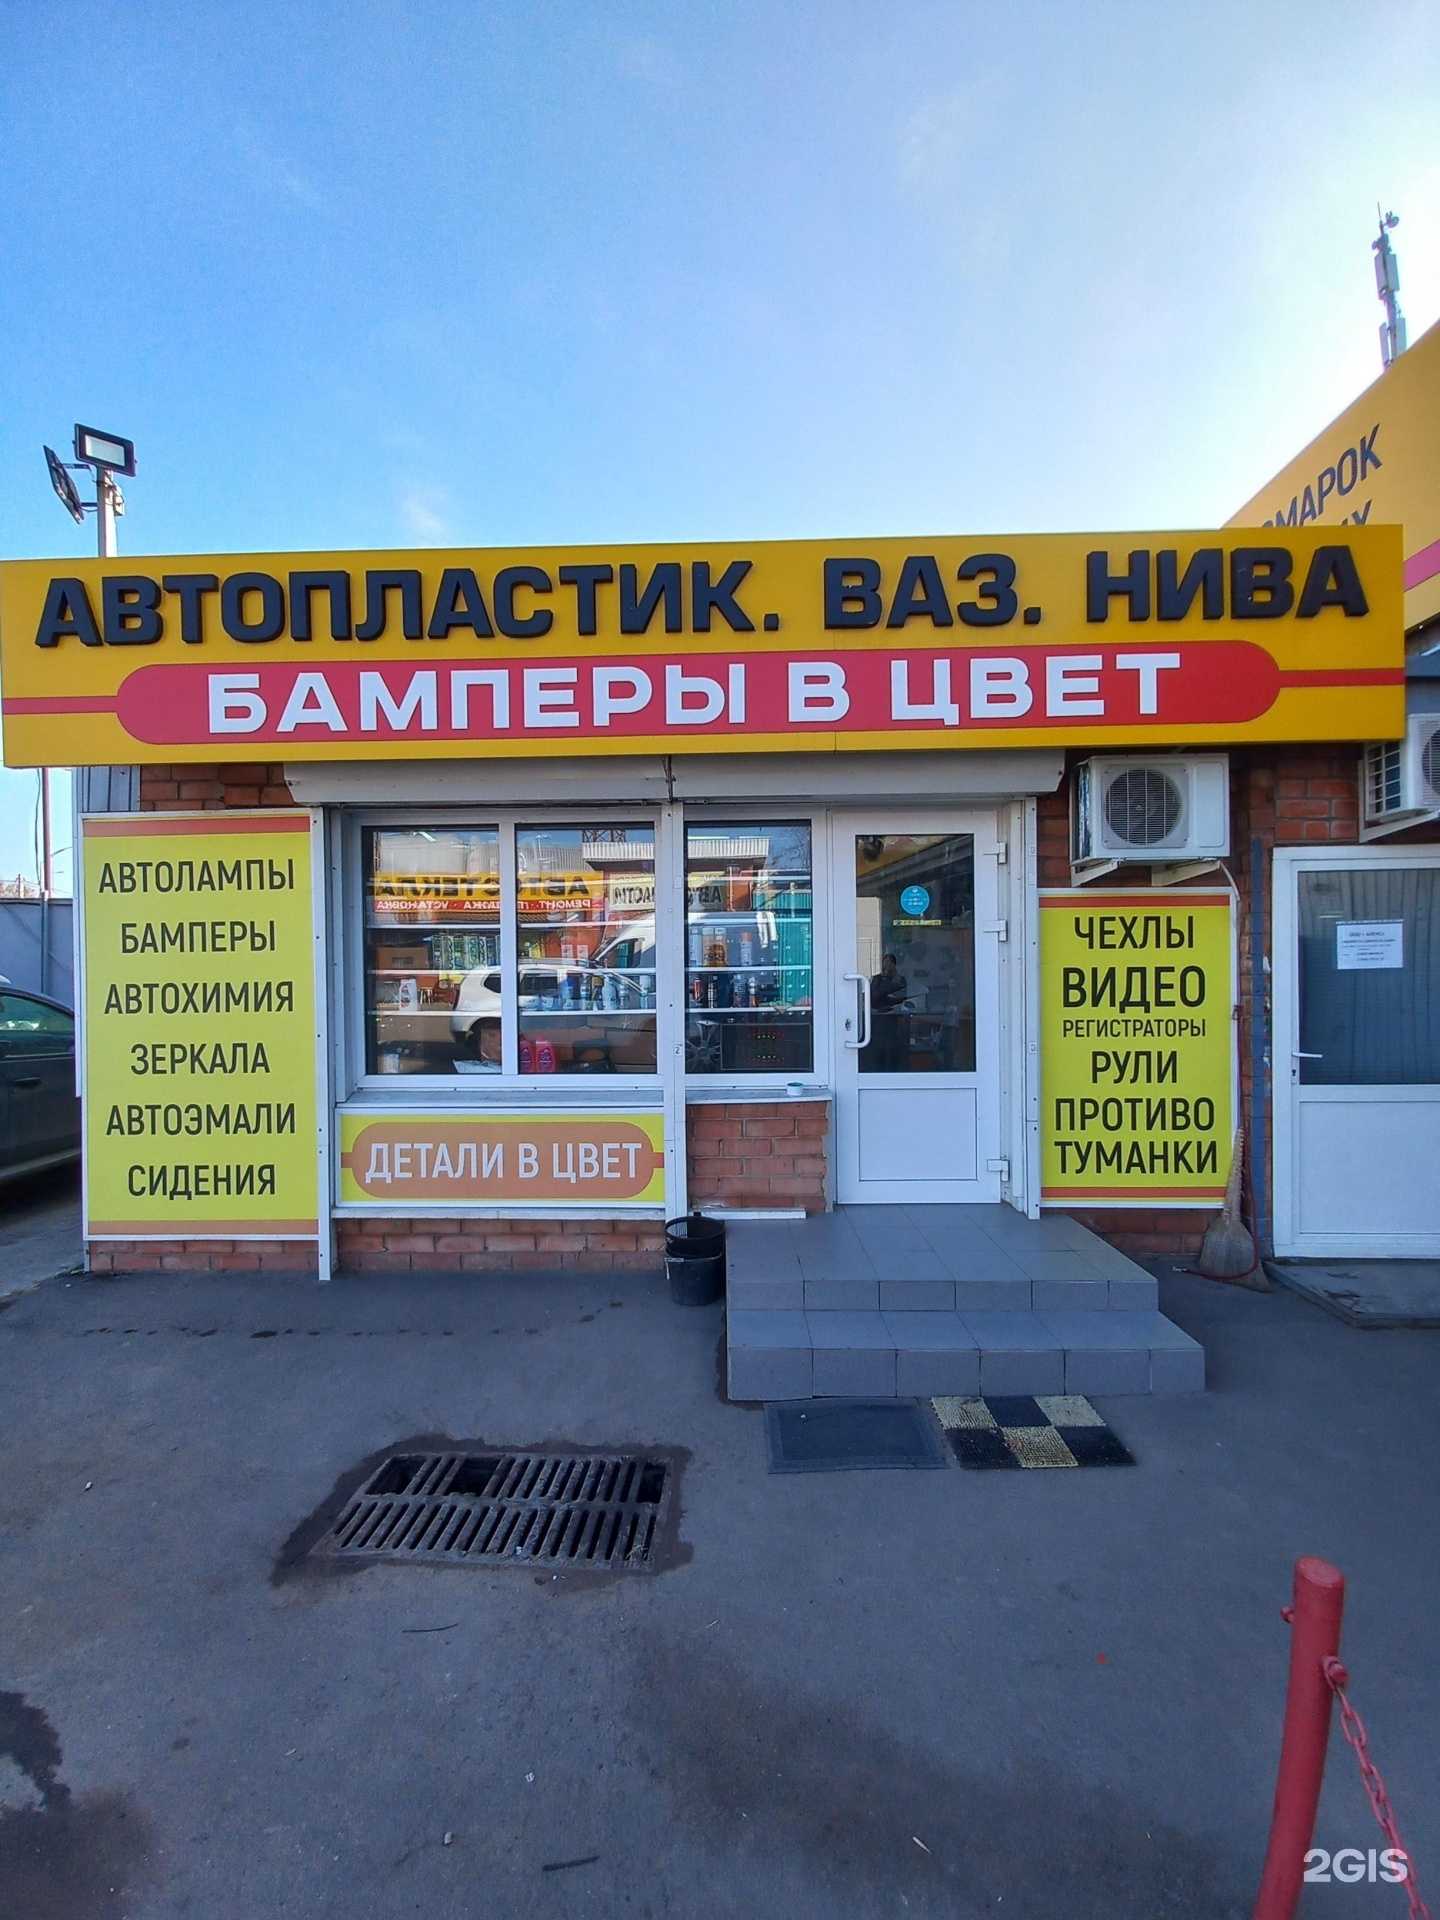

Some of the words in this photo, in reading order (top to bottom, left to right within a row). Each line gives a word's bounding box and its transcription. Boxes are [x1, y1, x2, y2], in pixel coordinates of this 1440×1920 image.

[36, 560, 779, 647] АВТОПЛАСТИК.
[823, 553, 1042, 629] ВАЗ.
[1085, 545, 1370, 622] НИВА
[207, 662, 746, 734] БАМПЕРЫ
[787, 661, 850, 723] В
[890, 652, 1181, 726] ЦВЕТ
[99, 859, 294, 893] АВТОЛАМПЫ
[121, 920, 276, 954] БАМПЕРЫ
[1074, 916, 1194, 949] ЧЕХЛЫ
[104, 981, 294, 1015] АВТОХИМИЯ
[1062, 965, 1206, 1014] ВИДЕО
[1063, 1019, 1206, 1038] РЕГИСТРАТОРЫ
[130, 1042, 270, 1075] ЗЕРКАЛА
[1092, 1051, 1177, 1084] РУЛИ
[106, 1103, 295, 1136] АВТОЭМАЛИ
[1056, 1097, 1215, 1131] ПРОТИВО
[365, 1143, 503, 1184] ДЕТАЛИ
[518, 1143, 540, 1179] В
[553, 1143, 642, 1184] ЦВЕТ
[1054, 1140, 1217, 1174] ТУМАНКИ
[128, 1164, 276, 1200] СИДЕНИЯ
